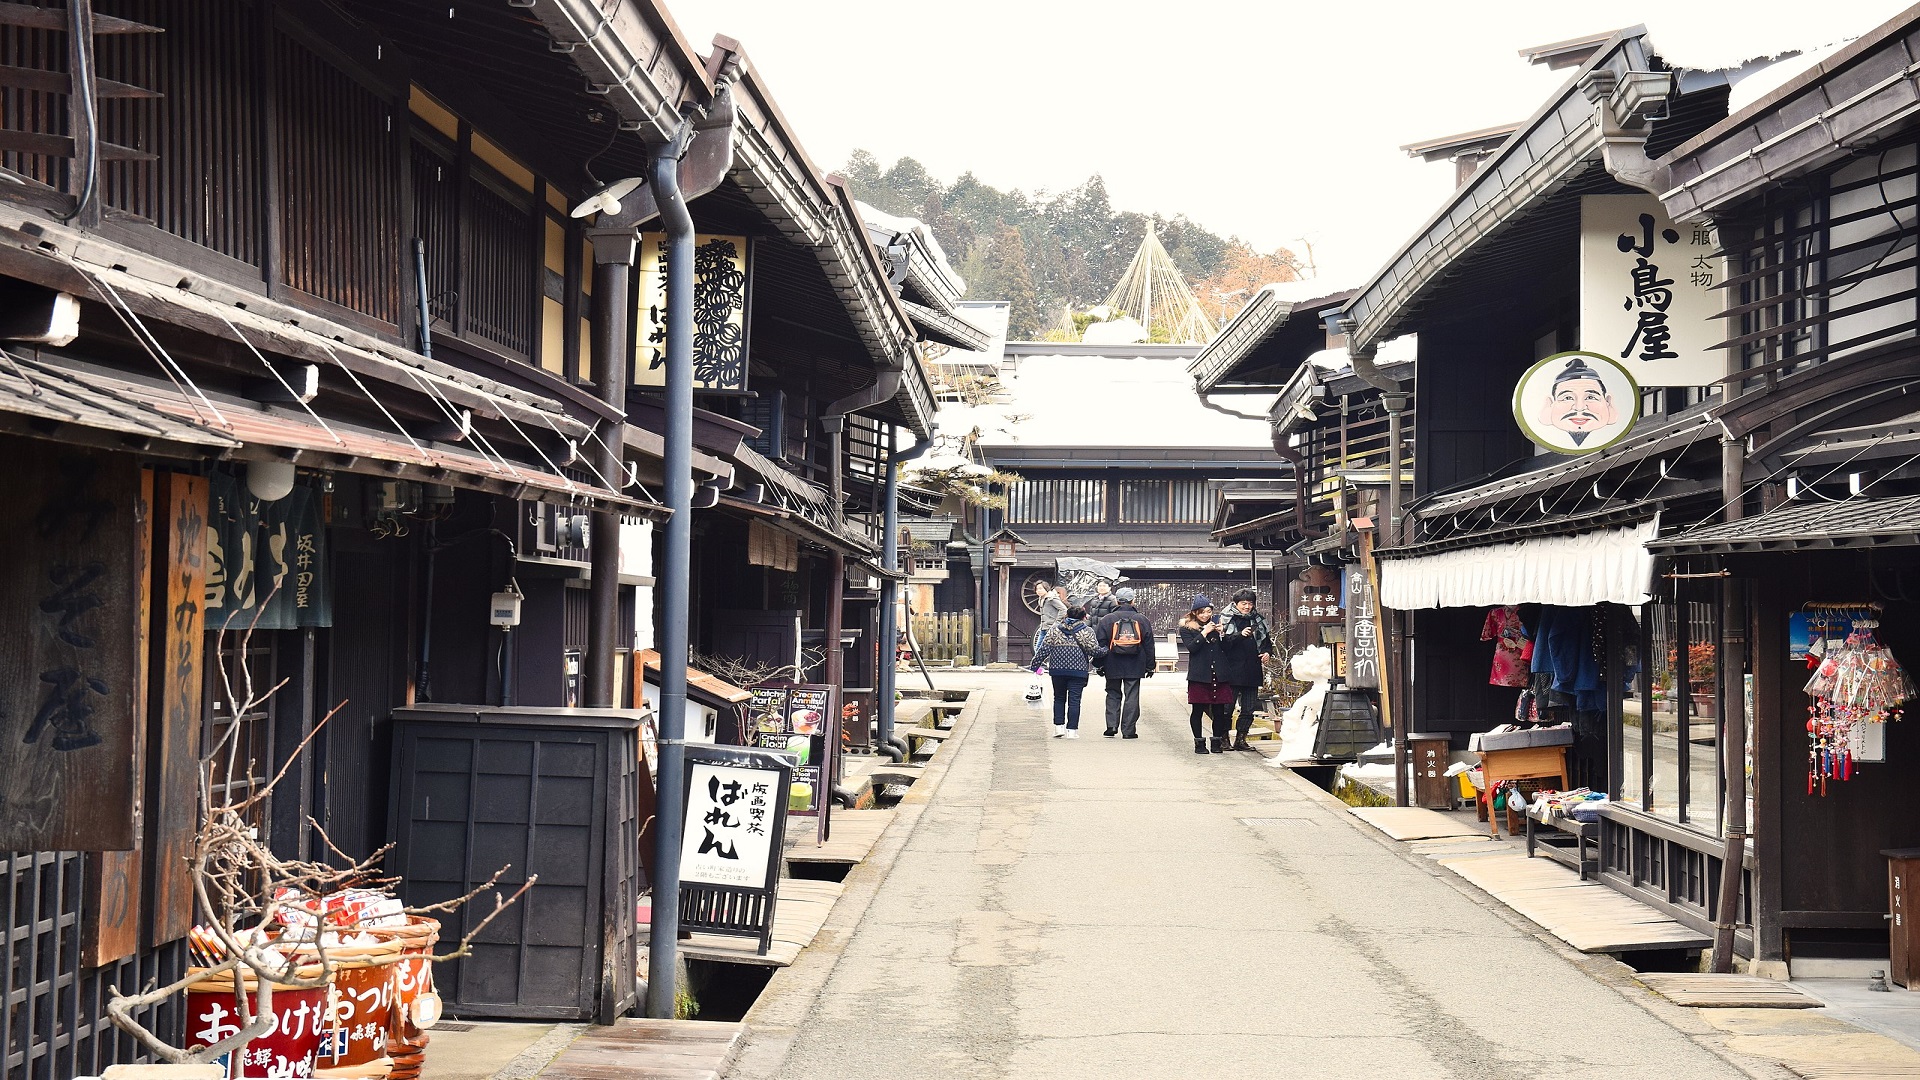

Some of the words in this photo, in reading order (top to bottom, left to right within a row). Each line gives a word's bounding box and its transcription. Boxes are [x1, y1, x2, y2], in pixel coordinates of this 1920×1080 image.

[1690, 222, 1711, 246] 服
[1617, 213, 1680, 362] 小鳥屋
[1690, 254, 1714, 287] 太物
[1300, 594, 1336, 602] 土産品
[697, 775, 749, 860] ばれん
[746, 782, 769, 836] 版画喫茶
